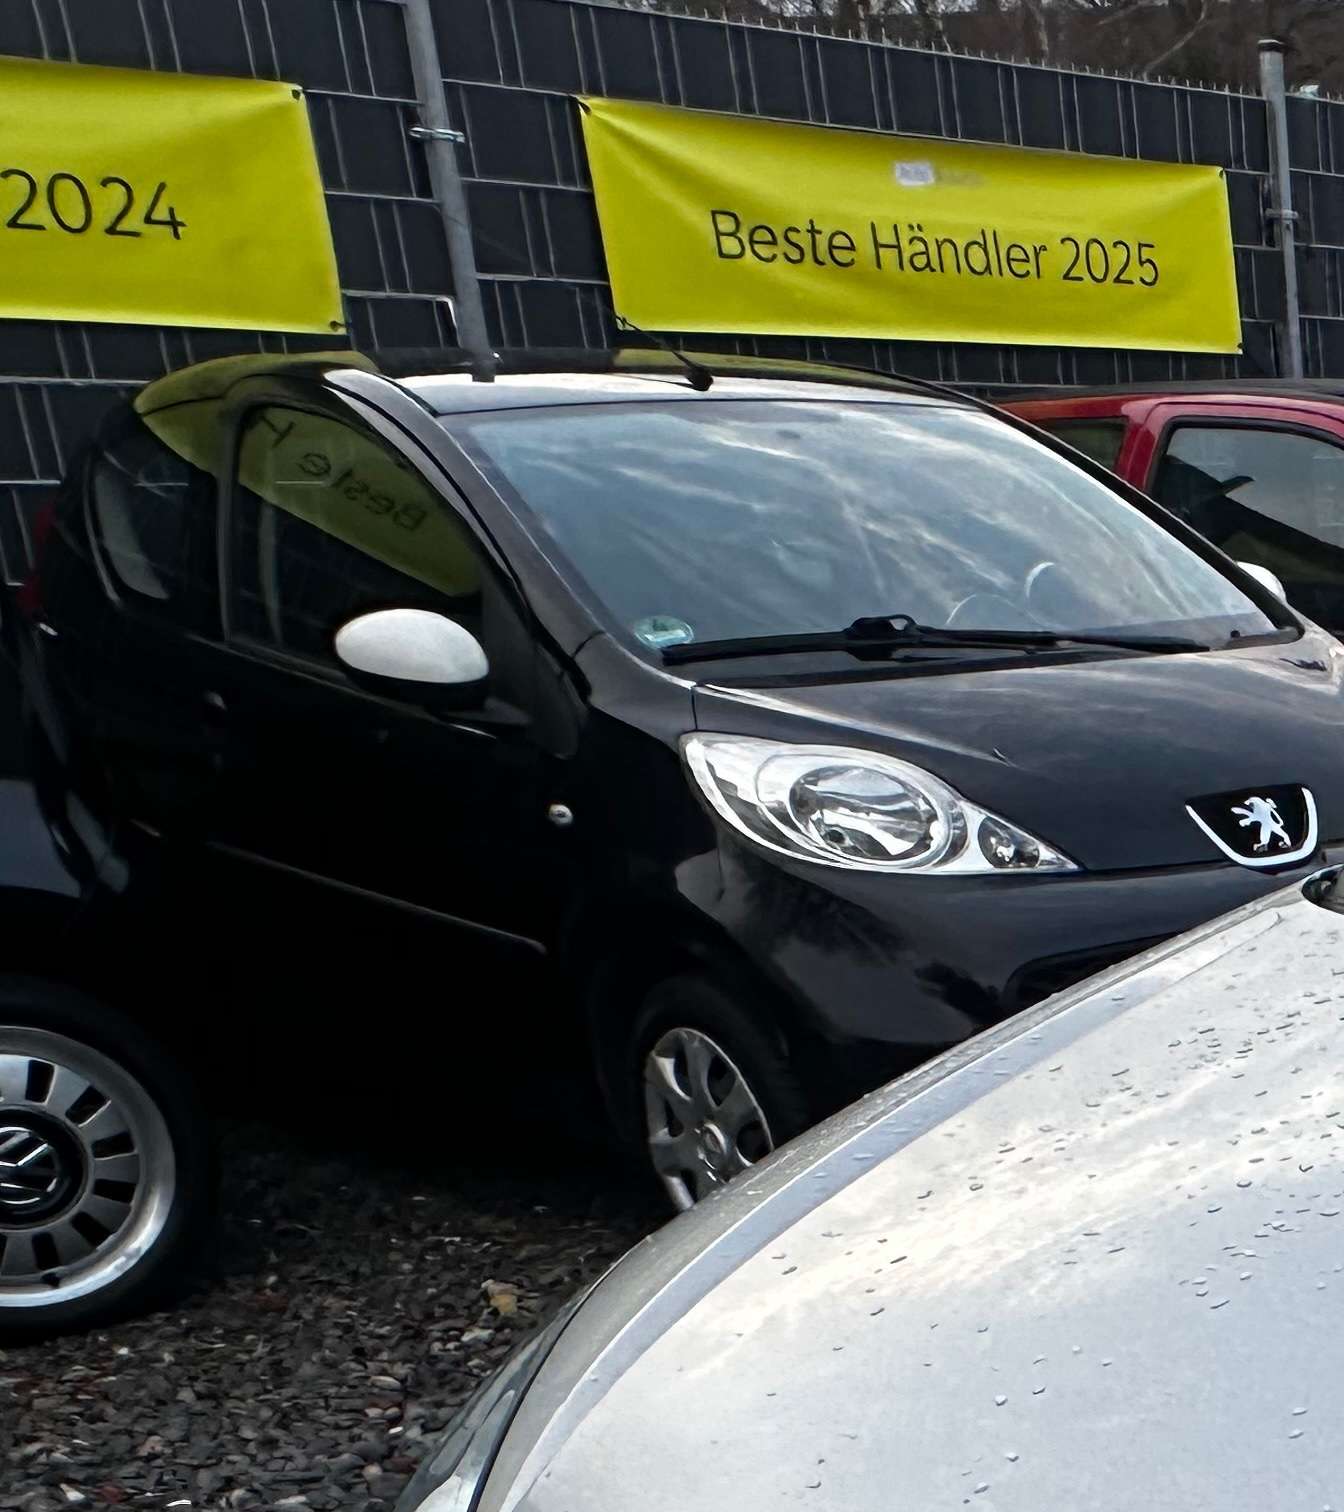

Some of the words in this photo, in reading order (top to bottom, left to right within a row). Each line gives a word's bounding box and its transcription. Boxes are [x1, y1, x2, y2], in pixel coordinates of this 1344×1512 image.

[1, 169, 187, 240] 2024
[711, 209, 856, 268] Beste
[870, 221, 1048, 280] Händler
[1060, 237, 1159, 287] 2025
